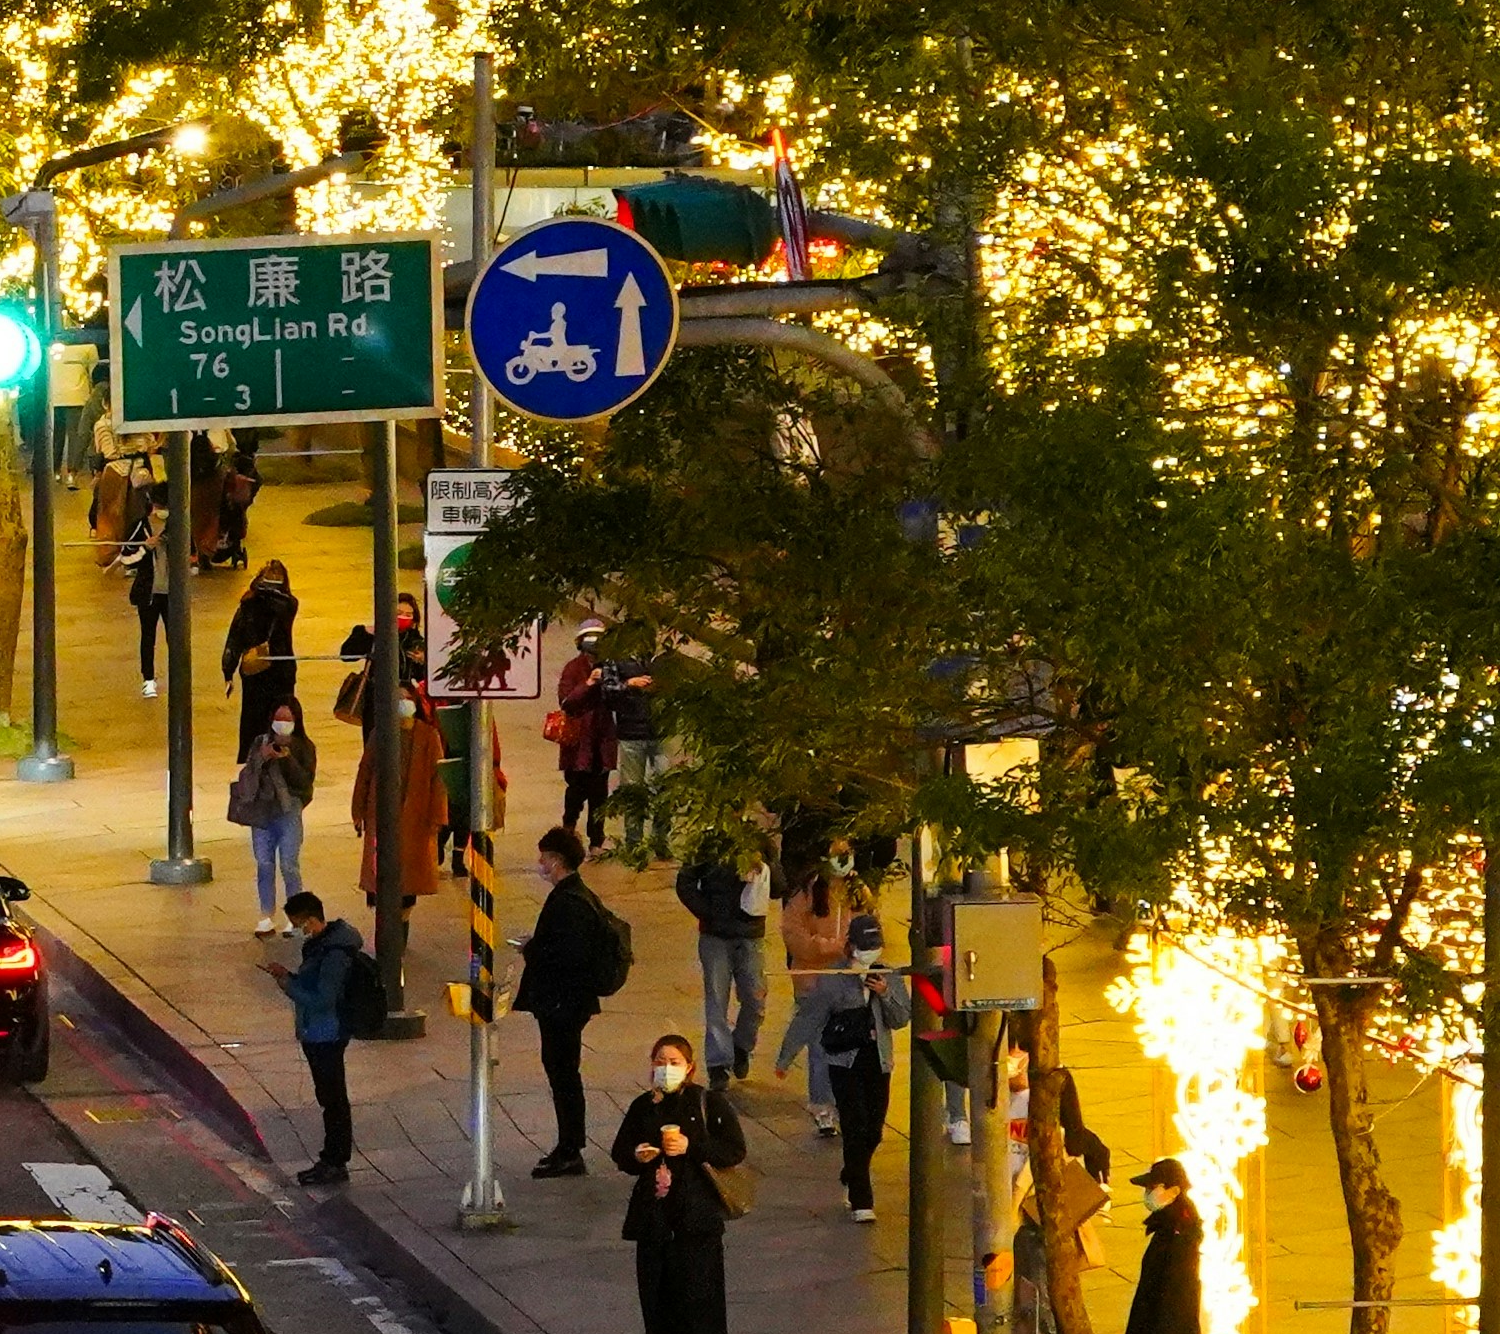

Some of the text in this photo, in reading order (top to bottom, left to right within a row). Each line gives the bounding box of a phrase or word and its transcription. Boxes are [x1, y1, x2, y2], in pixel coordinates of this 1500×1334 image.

[153, 249, 393, 314] 松廉路
[180, 318, 318, 348] SongLian
[191, 354, 230, 381] 76
[431, 481, 532, 501] 限制高污
